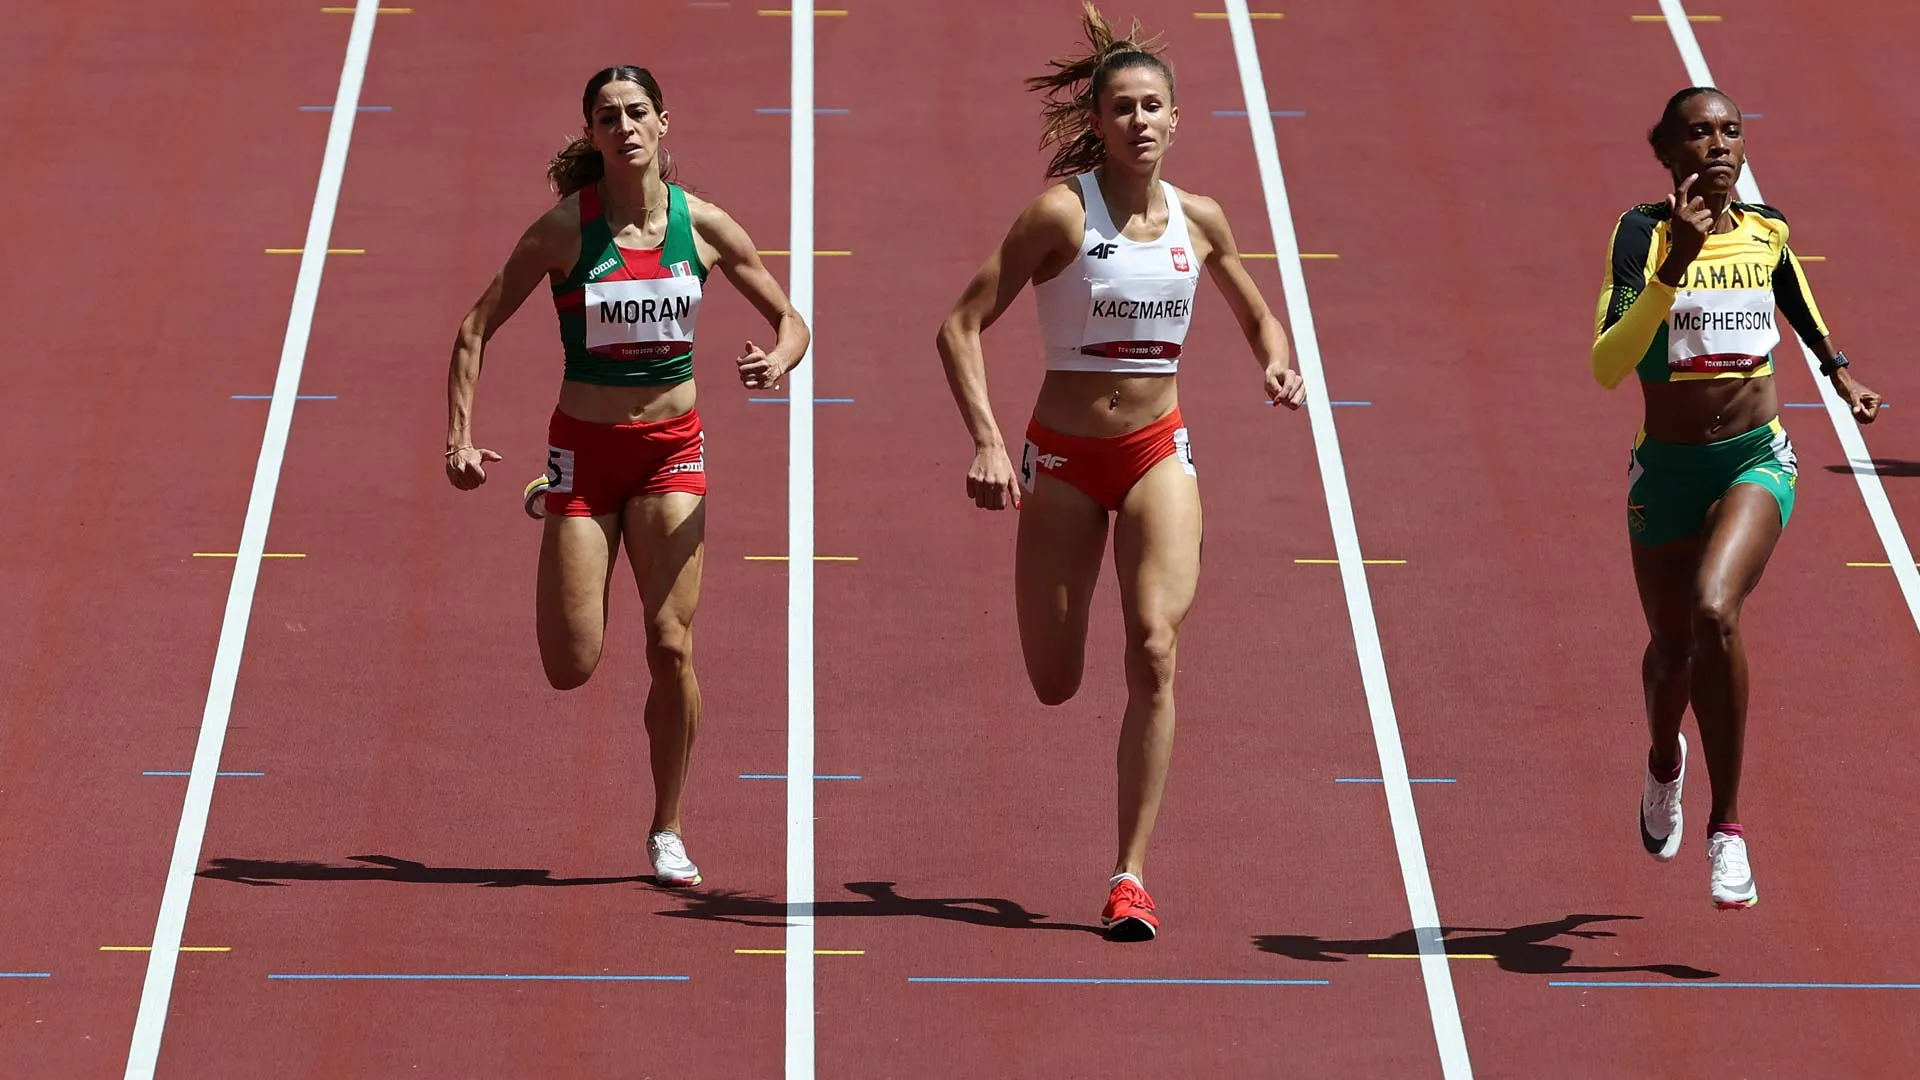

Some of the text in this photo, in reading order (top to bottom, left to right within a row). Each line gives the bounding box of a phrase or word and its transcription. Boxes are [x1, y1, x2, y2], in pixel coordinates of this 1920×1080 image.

[1087, 243, 1118, 259] 4F
[600, 296, 690, 324] MORAN
[1092, 298, 1190, 319] KACZMAREK
[1673, 311, 1771, 331] McPHERSON
[547, 449, 562, 487] 5
[669, 462, 704, 473] Jom
[1037, 453, 1068, 470] 4F
